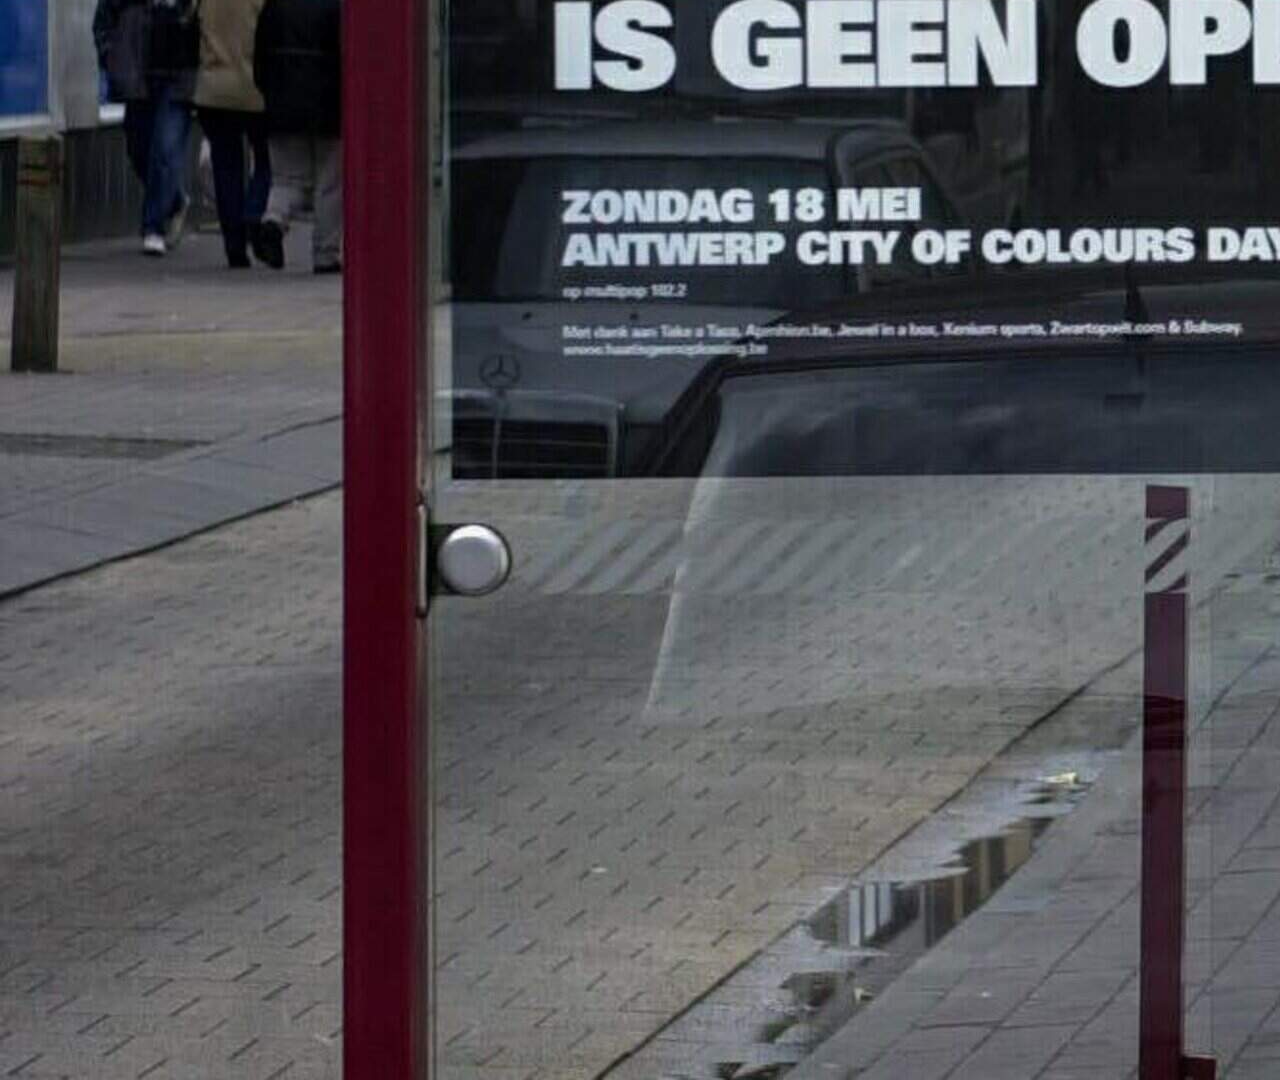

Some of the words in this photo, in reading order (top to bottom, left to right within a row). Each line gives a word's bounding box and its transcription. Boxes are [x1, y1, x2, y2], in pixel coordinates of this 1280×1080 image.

[555, 0, 676, 91] IS
[562, 188, 755, 224] ZONDAG
[768, 187, 825, 223] 18
[837, 186, 922, 222] MEI
[561, 231, 786, 267] ANTWERP
[796, 230, 901, 265] CITY
[911, 229, 972, 265] OF
[981, 227, 1195, 264] COLOURS
[594, 324, 628, 339] dank
[631, 328, 658, 339] aan
